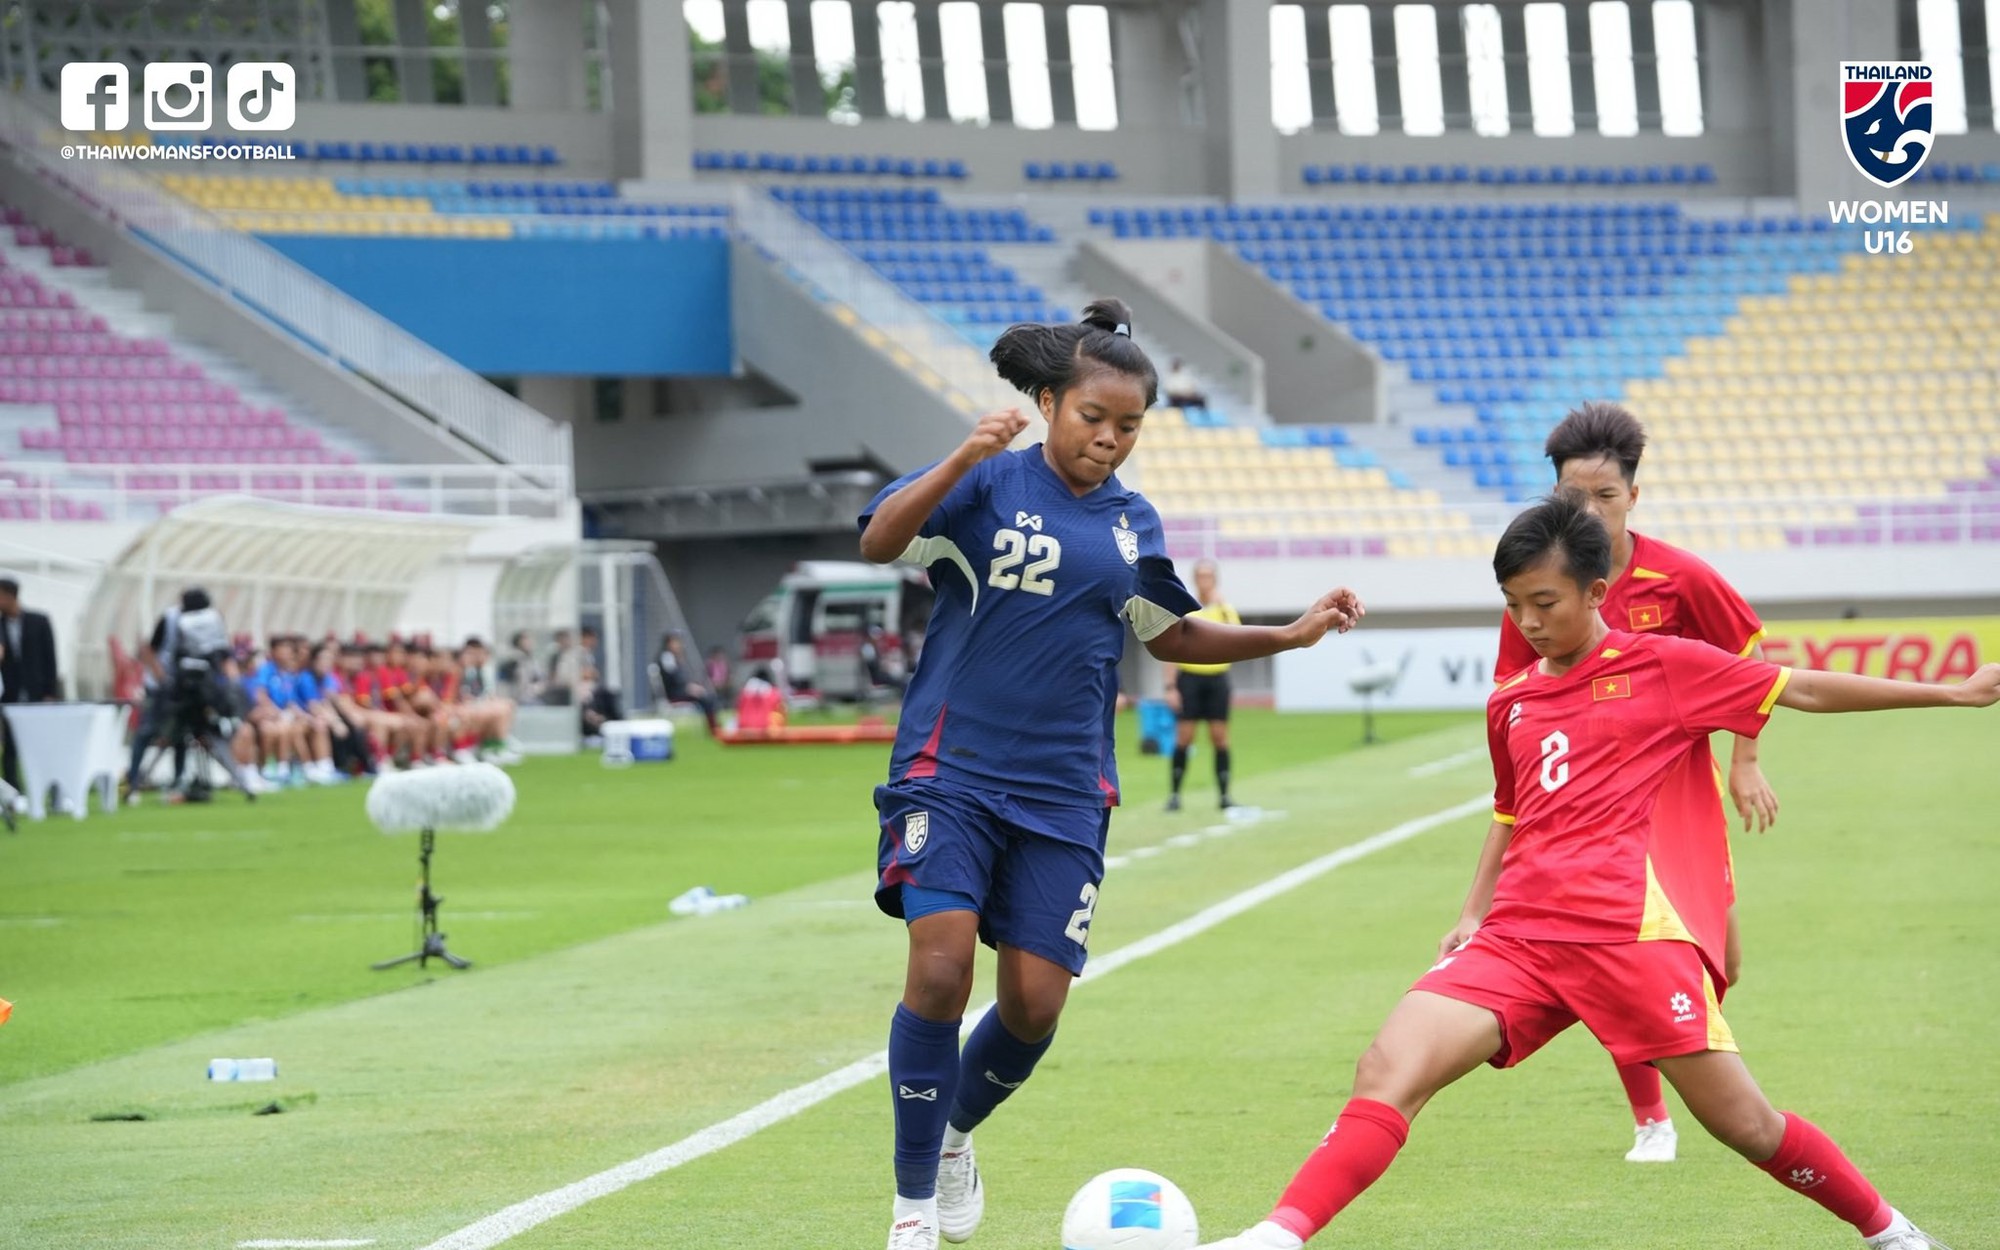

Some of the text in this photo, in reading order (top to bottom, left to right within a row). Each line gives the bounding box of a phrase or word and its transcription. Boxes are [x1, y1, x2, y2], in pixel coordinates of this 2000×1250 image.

[987, 528, 1061, 596] 22
[1441, 656, 1484, 684] VI
[1762, 634, 1980, 684] EXTRA
[1540, 729, 1569, 793] 2
[1064, 882, 1099, 946] 2
